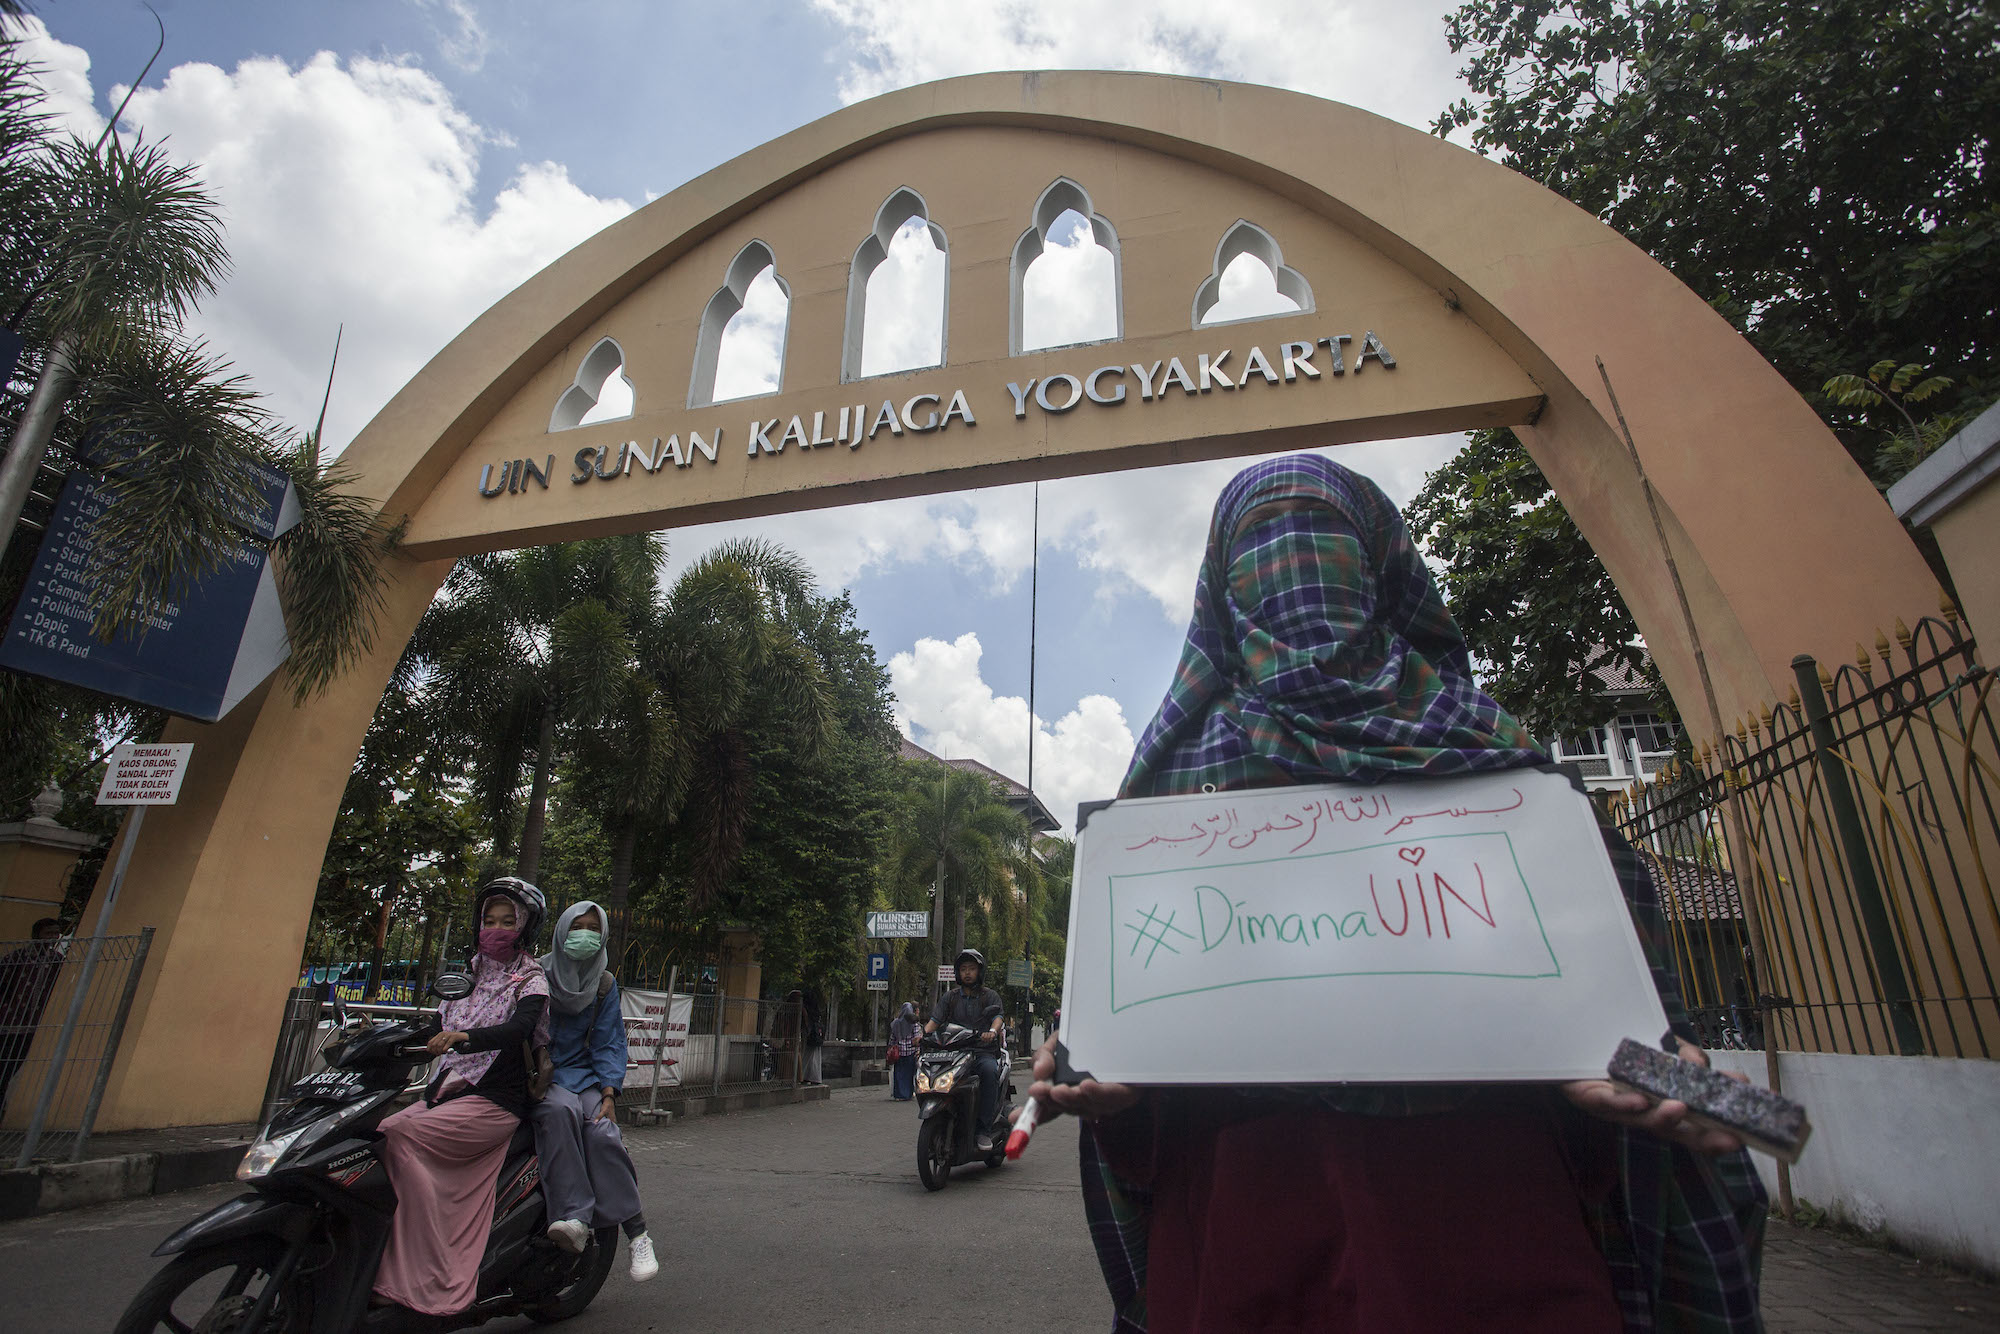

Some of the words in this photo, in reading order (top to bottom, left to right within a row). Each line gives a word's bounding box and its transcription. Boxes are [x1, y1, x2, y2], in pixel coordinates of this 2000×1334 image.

[480, 454, 554, 498] UIN
[570, 428, 723, 484] SUNAN
[747, 389, 977, 458] KALIJAGA
[1006, 329, 1397, 419] YOGYAKARTA
[60, 546, 87, 567] Staf
[40, 595, 96, 624] Poliklinik
[33, 612, 69, 635] Dapic
[29, 628, 48, 646] TK
[47, 635, 57, 649] &
[59, 638, 91, 659] Paud
[133, 749, 171, 757] MEMAKAI
[116, 770, 148, 778] SANDAL
[150, 769, 174, 778] JEPIT
[118, 759, 142, 768] KAOS
[115, 780, 140, 789] TIDAK
[140, 780, 169, 789] BOLEH
[105, 791, 135, 800] MASUK
[135, 791, 172, 800] KAMPUS
[872, 957, 885, 976] P
[327, 1148, 372, 1170] HONDA
